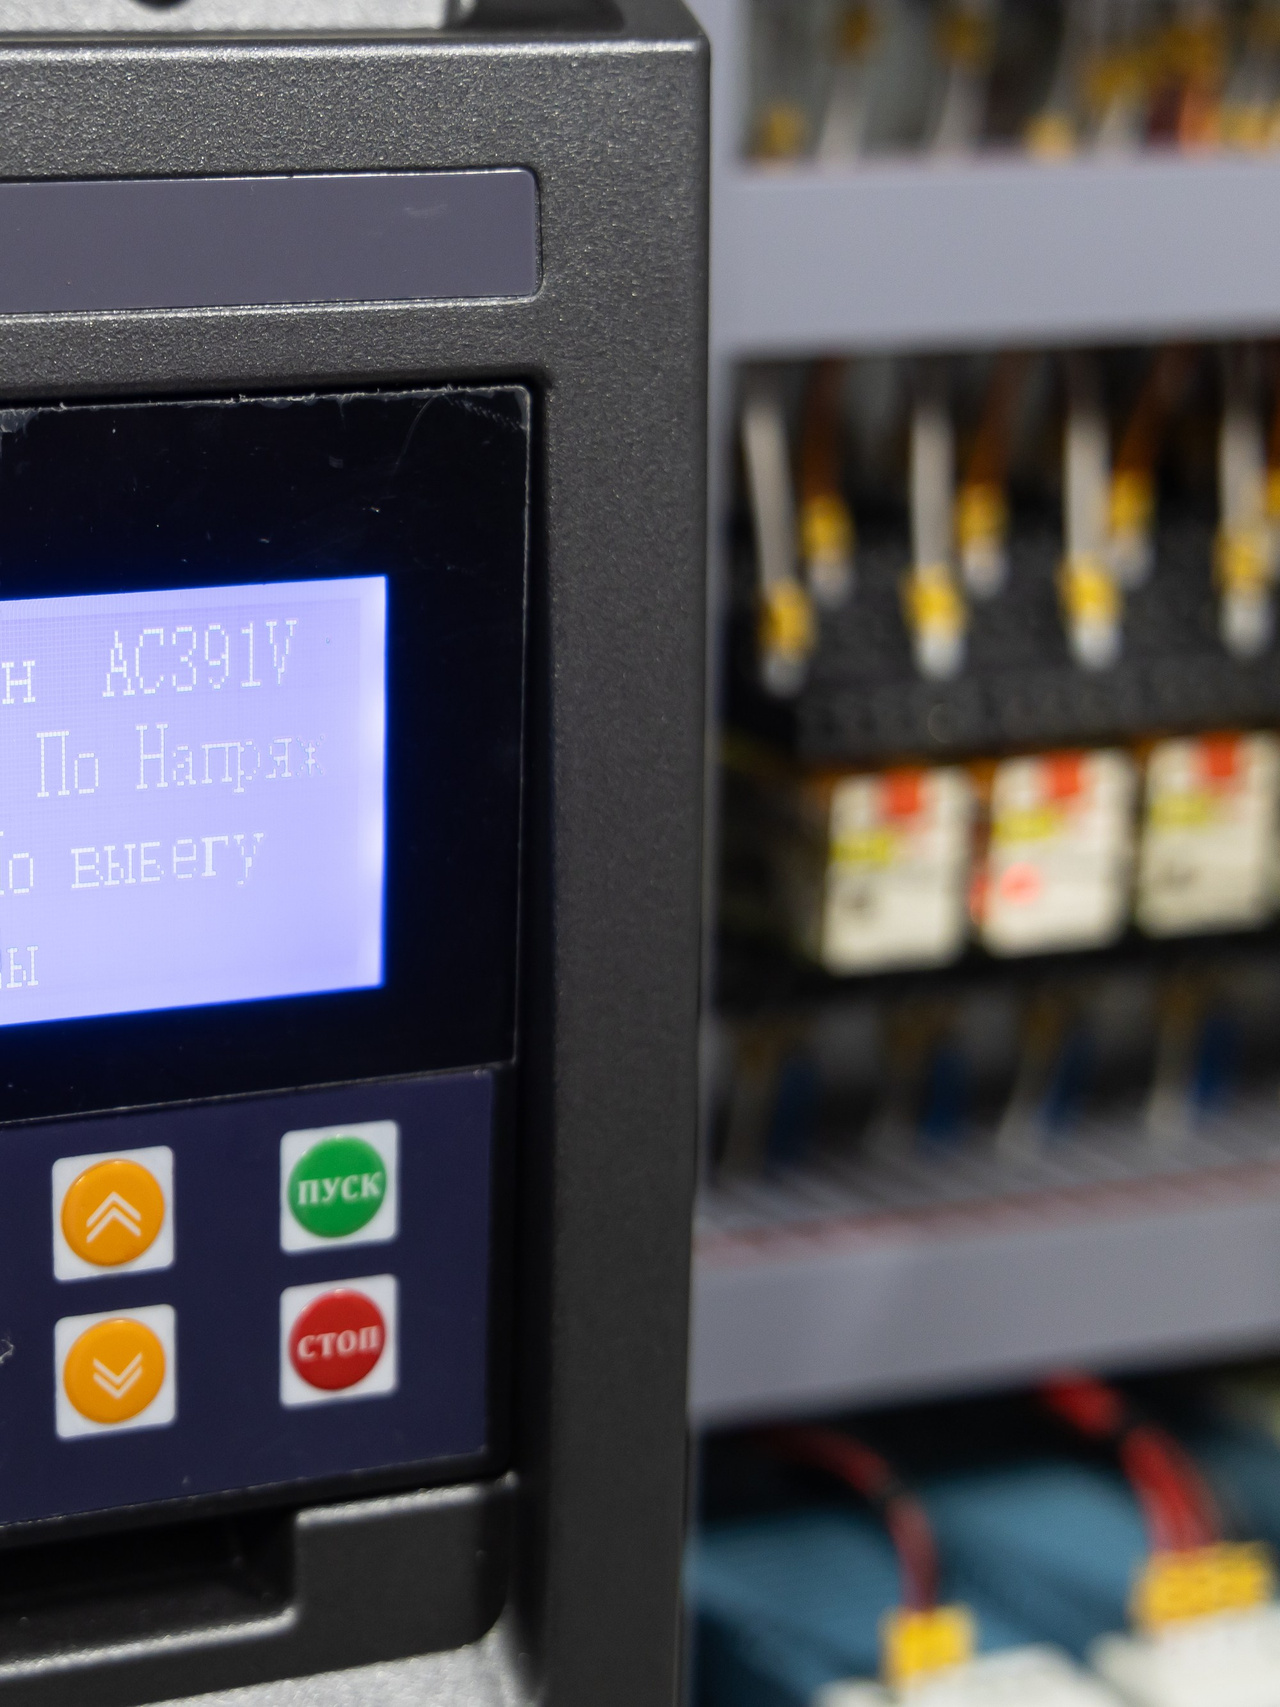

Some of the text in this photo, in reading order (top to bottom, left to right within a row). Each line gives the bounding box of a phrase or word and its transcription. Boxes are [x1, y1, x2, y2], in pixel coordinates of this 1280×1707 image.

[36, 730, 99, 798] По
[135, 723, 325, 794] Напряж
[297, 1172, 382, 1206] ПУСК
[297, 1326, 381, 1361] СТОП
